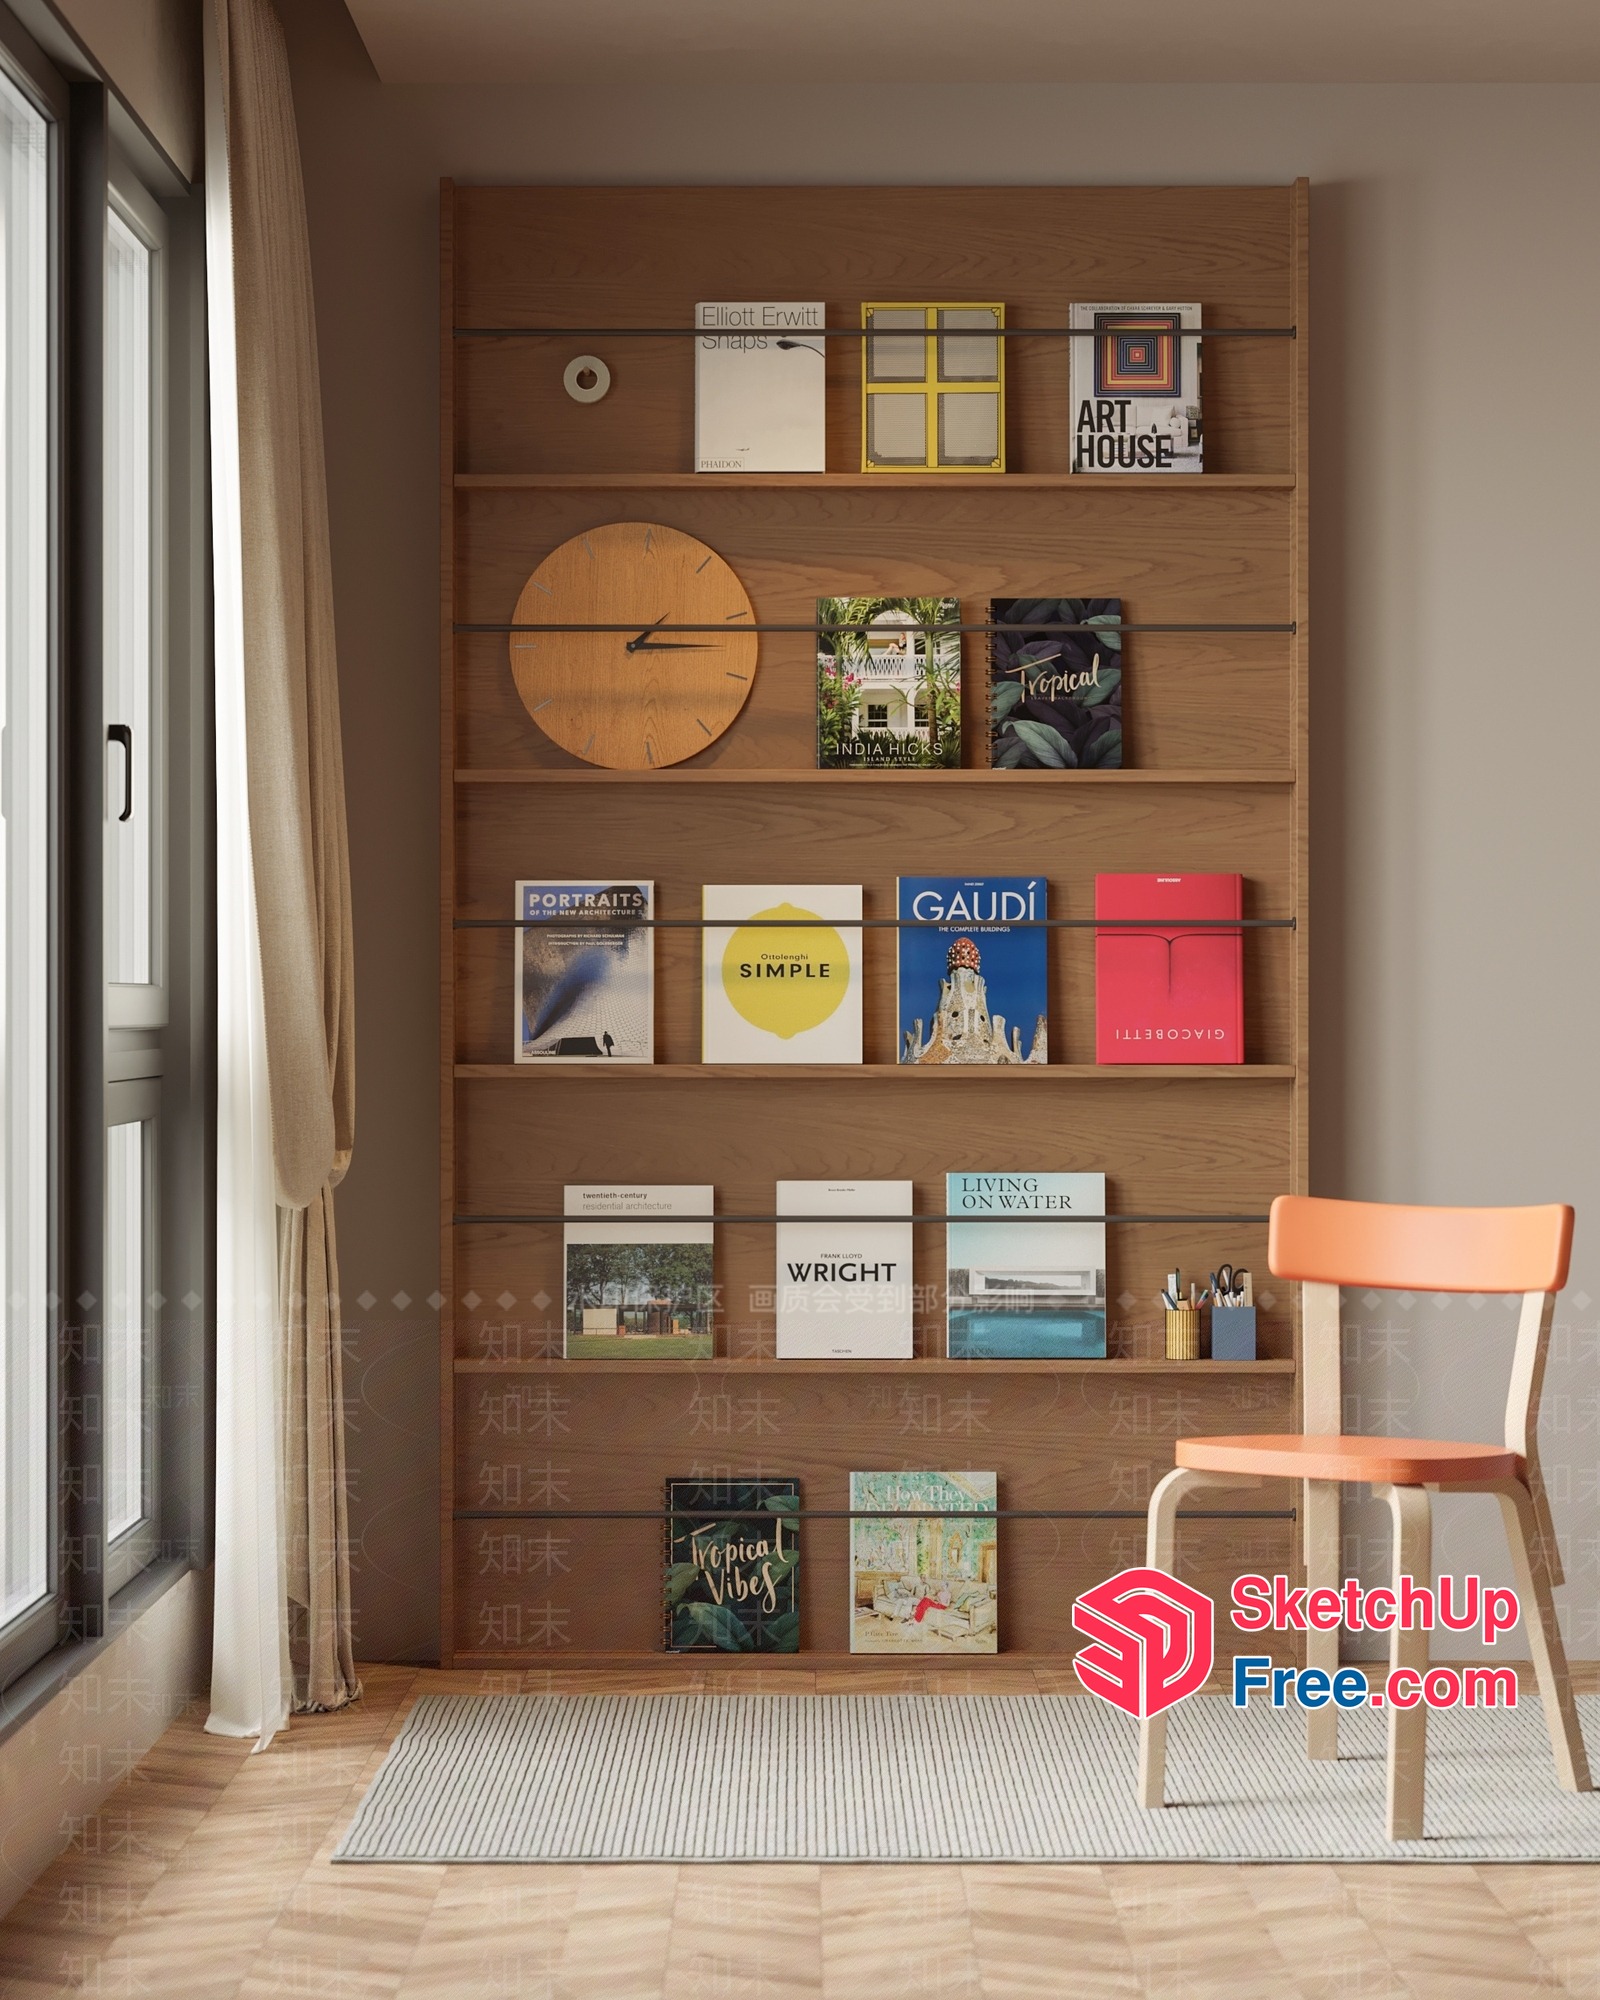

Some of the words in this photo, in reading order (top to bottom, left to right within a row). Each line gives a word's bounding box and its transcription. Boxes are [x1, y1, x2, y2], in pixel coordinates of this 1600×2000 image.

[702, 306, 755, 327] Elliott
[762, 306, 818, 327] Erwitt
[702, 335, 768, 353] Snaps
[1076, 400, 1132, 433] ART
[1076, 434, 1172, 468] HOUSE
[700, 460, 742, 469] PHAIDON
[1004, 652, 1102, 704] Tropical
[836, 742, 883, 755] INDIA
[889, 742, 943, 755] HICKS
[529, 893, 643, 908] PORTRAITS
[912, 880, 1037, 920] GAUDÍ
[760, 953, 809, 961] Ottolenghi
[740, 963, 830, 978] SIMPLE
[1115, 1029, 1225, 1040] GIACOBETTI
[961, 1178, 1039, 1192] LIVING
[582, 1192, 648, 1200] twentieth-century
[962, 1195, 993, 1209] ON
[998, 1195, 1072, 1209] WATER
[582, 1202, 624, 1210] residential
[625, 1202, 672, 1210] architecture
[787, 1262, 897, 1282] WRIGHT
[887, 1485, 921, 1501] How
[924, 1485, 965, 1504] They
[673, 1518, 789, 1580] Tropical
[704, 1561, 782, 1613] Vibes
